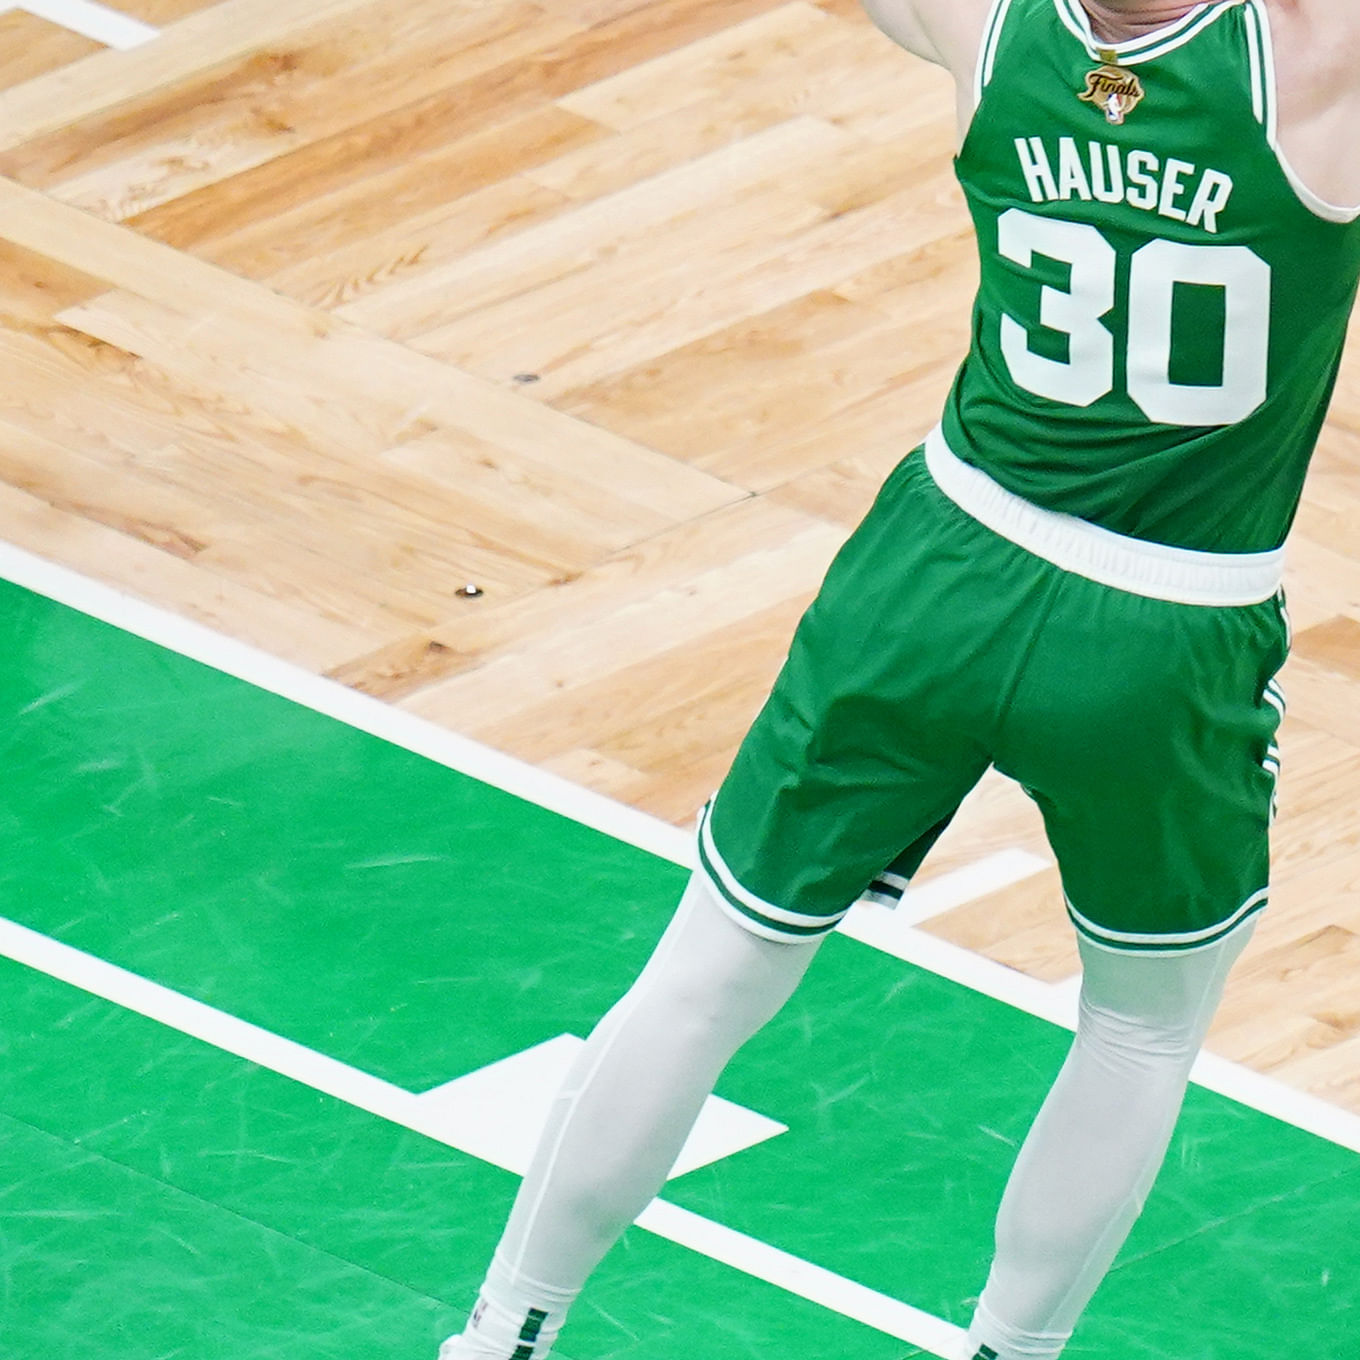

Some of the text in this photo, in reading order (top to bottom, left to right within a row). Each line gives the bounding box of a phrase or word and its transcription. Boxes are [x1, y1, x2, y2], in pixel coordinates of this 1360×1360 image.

[1083, 72, 1141, 99] Finals
[1014, 136, 1233, 234] HAUSER
[997, 207, 1272, 426] 30
